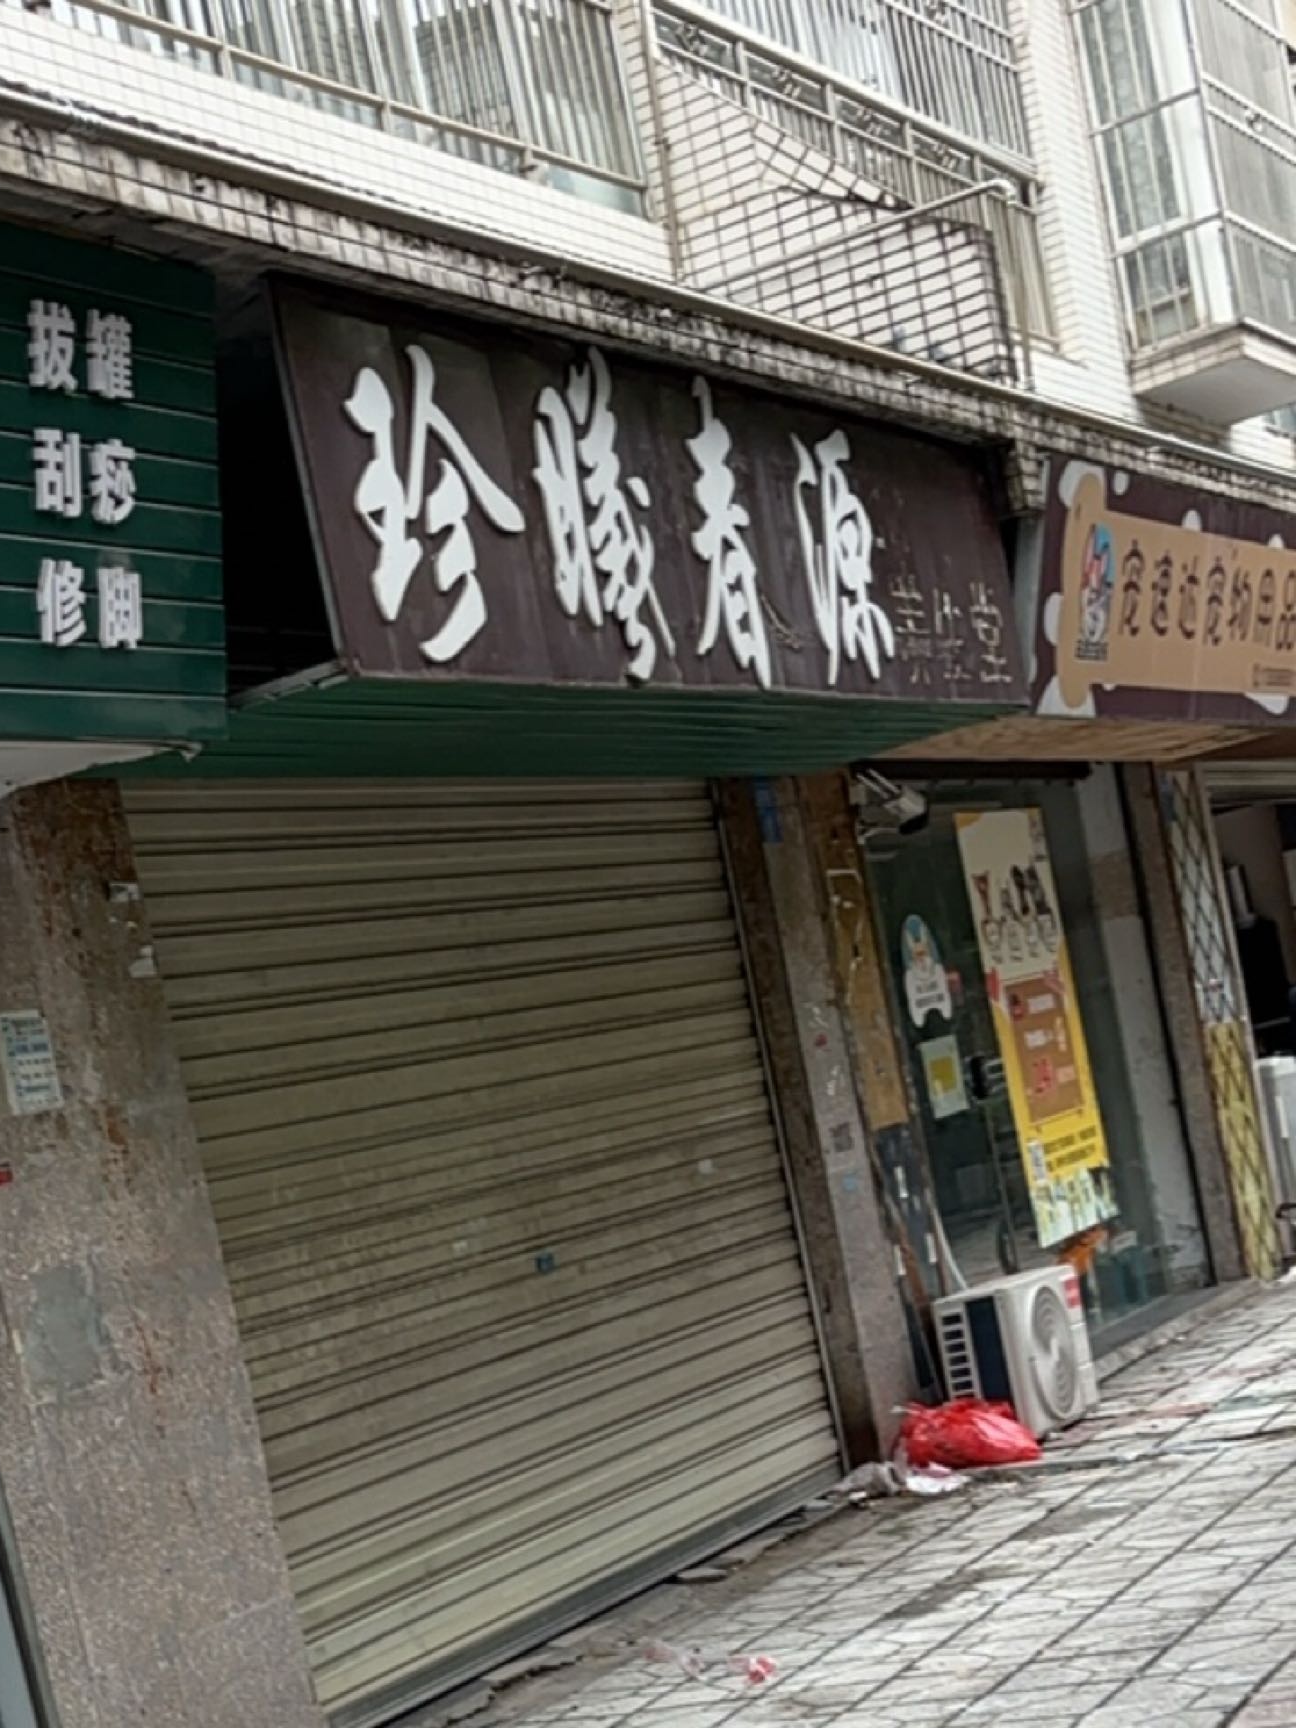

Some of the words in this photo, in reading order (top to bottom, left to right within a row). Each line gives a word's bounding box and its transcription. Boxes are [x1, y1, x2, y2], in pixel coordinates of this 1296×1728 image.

[28, 299, 134, 400] 拔罐
[33, 428, 137, 524] 刮痧
[36, 557, 143, 650] 修脚
